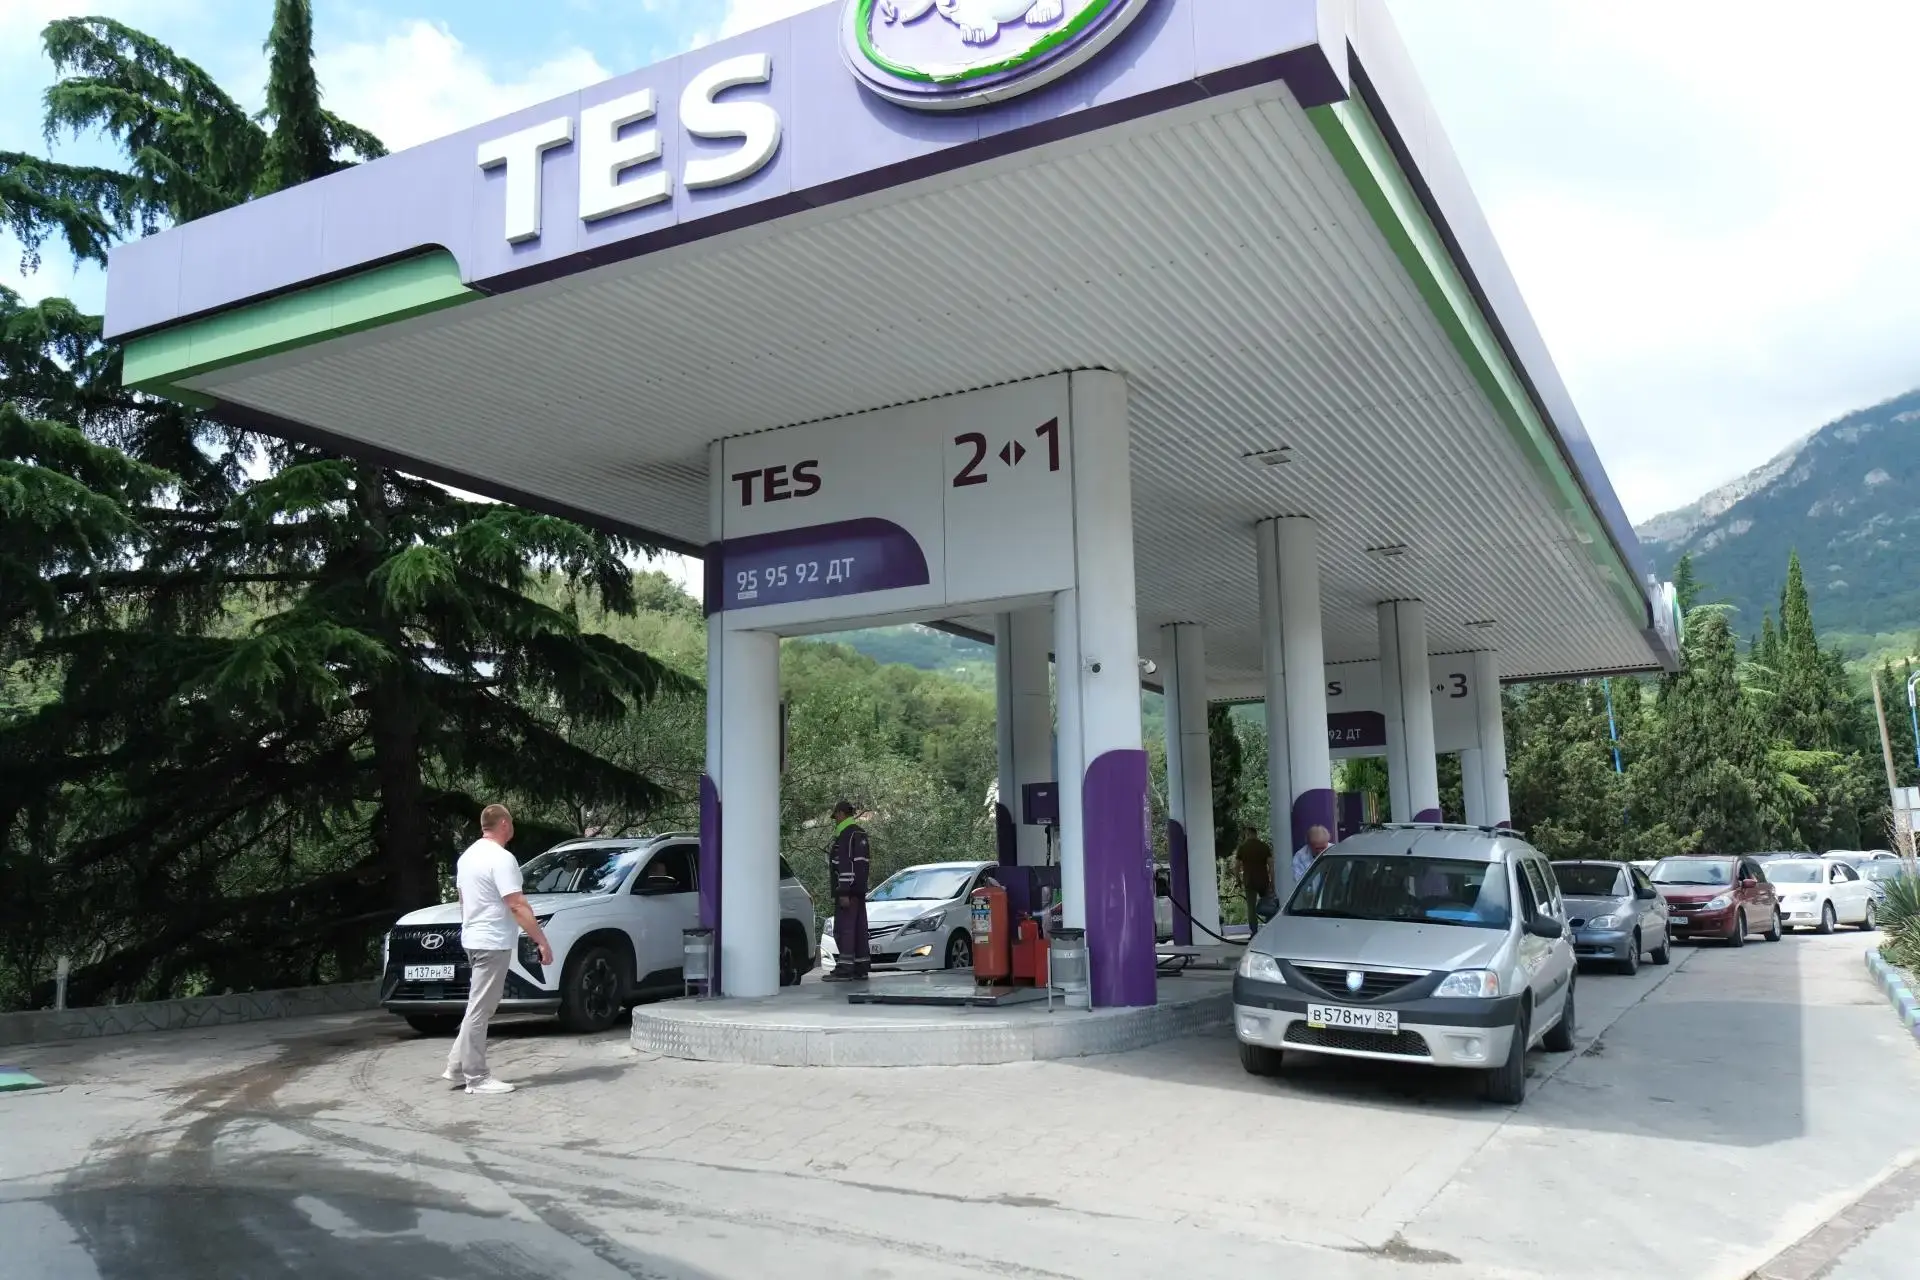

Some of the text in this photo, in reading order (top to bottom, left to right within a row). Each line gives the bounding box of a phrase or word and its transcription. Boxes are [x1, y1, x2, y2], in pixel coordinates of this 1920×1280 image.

[477, 53, 782, 244] TES
[953, 416, 1060, 488] 2 1
[732, 459, 822, 507] TES
[737, 557, 855, 591] 95 95 92 ДТ
[1449, 673, 1468, 698] 3
[1346, 728, 1361, 741] ДТ
[1377, 1006, 1393, 1024] 82
